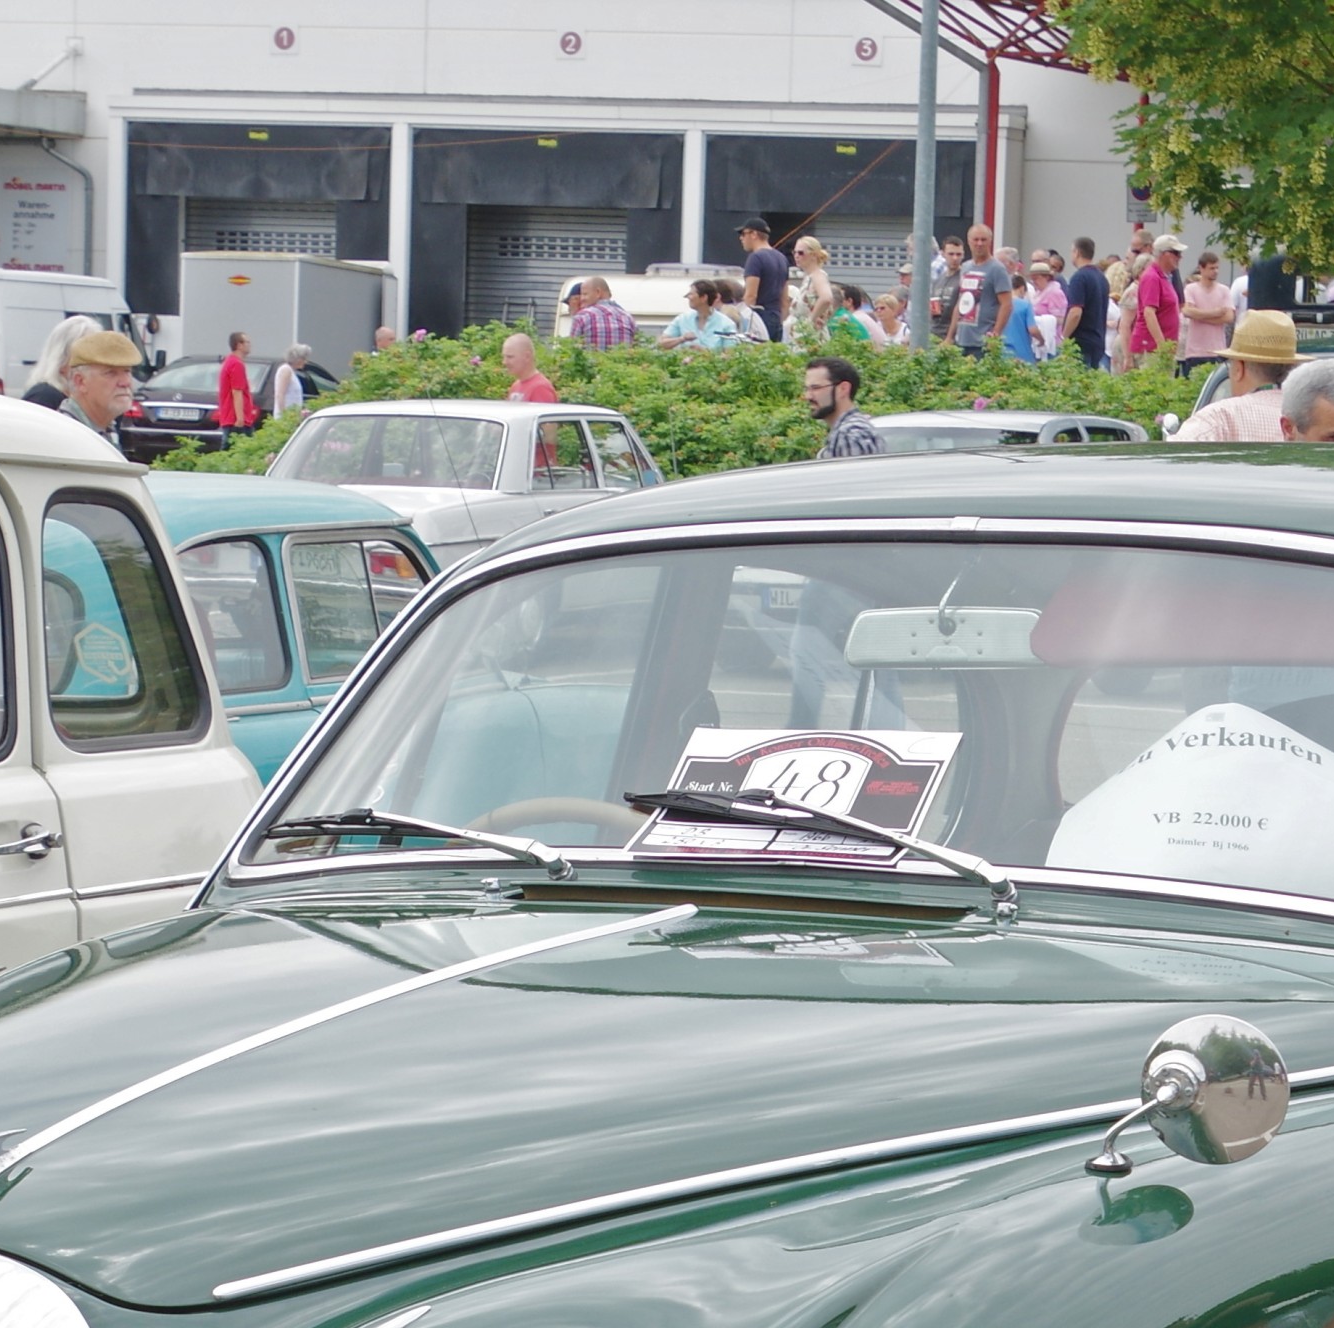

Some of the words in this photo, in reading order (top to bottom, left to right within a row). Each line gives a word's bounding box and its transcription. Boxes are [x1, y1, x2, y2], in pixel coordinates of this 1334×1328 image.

[279, 30, 287, 47] 1
[565, 35, 576, 52] 2
[861, 39, 872, 56] 3
[1165, 727, 1323, 765] Verkaufen
[686, 780, 714, 792] Start
[718, 781, 733, 792] Nr.
[768, 758, 852, 808] 48
[1153, 811, 1181, 824] VB
[1192, 812, 1251, 829] 22.000
[1257, 818, 1269, 830] €
[1167, 837, 1206, 847] Daimler
[1212, 840, 1224, 850] Bj
[1227, 842, 1249, 851] 1966
